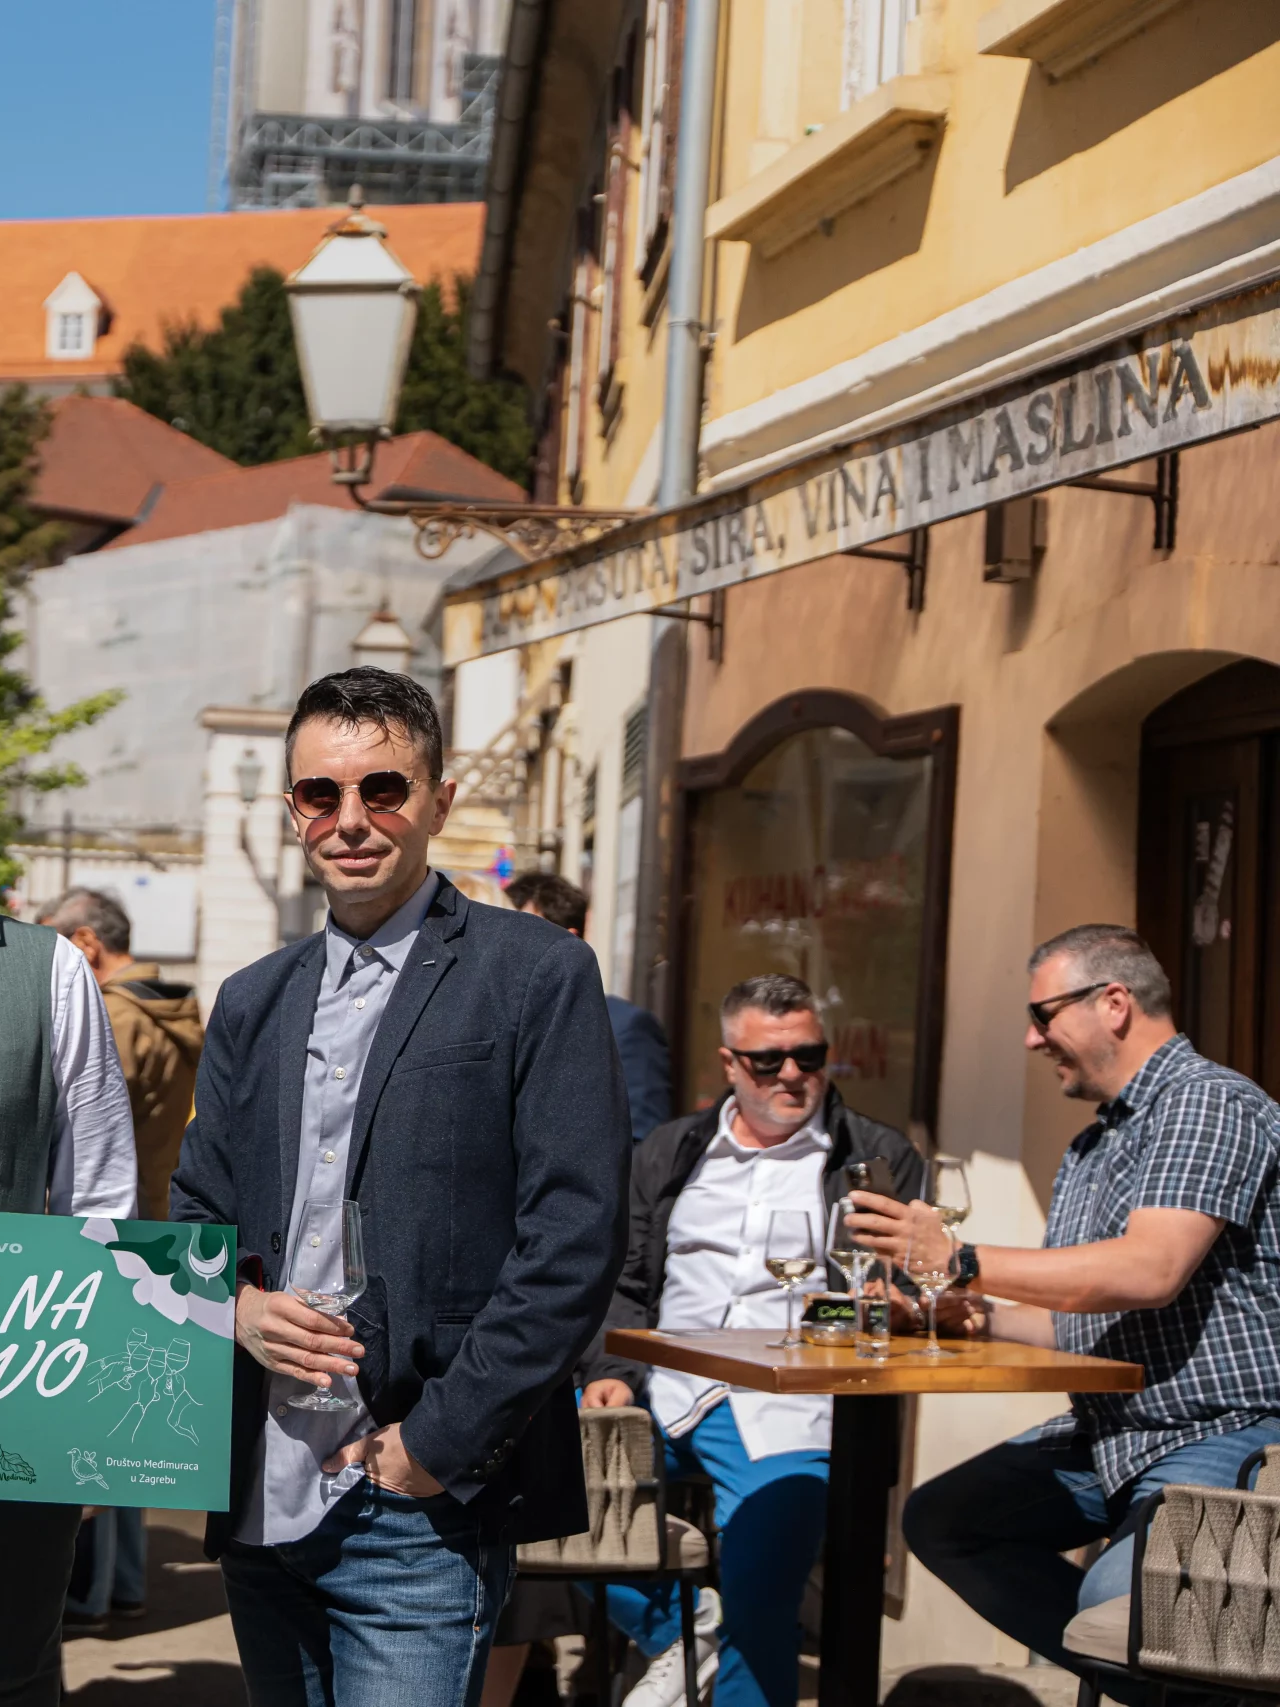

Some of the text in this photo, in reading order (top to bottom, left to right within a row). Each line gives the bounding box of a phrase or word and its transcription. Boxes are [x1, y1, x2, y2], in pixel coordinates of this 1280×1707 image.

[800, 451, 906, 538] VINA
[918, 436, 933, 501] I
[946, 341, 1214, 493] MASLINA
[106, 1456, 199, 1472] Društvo Međimuraca
[130, 1473, 177, 1487] u Zagrebu
